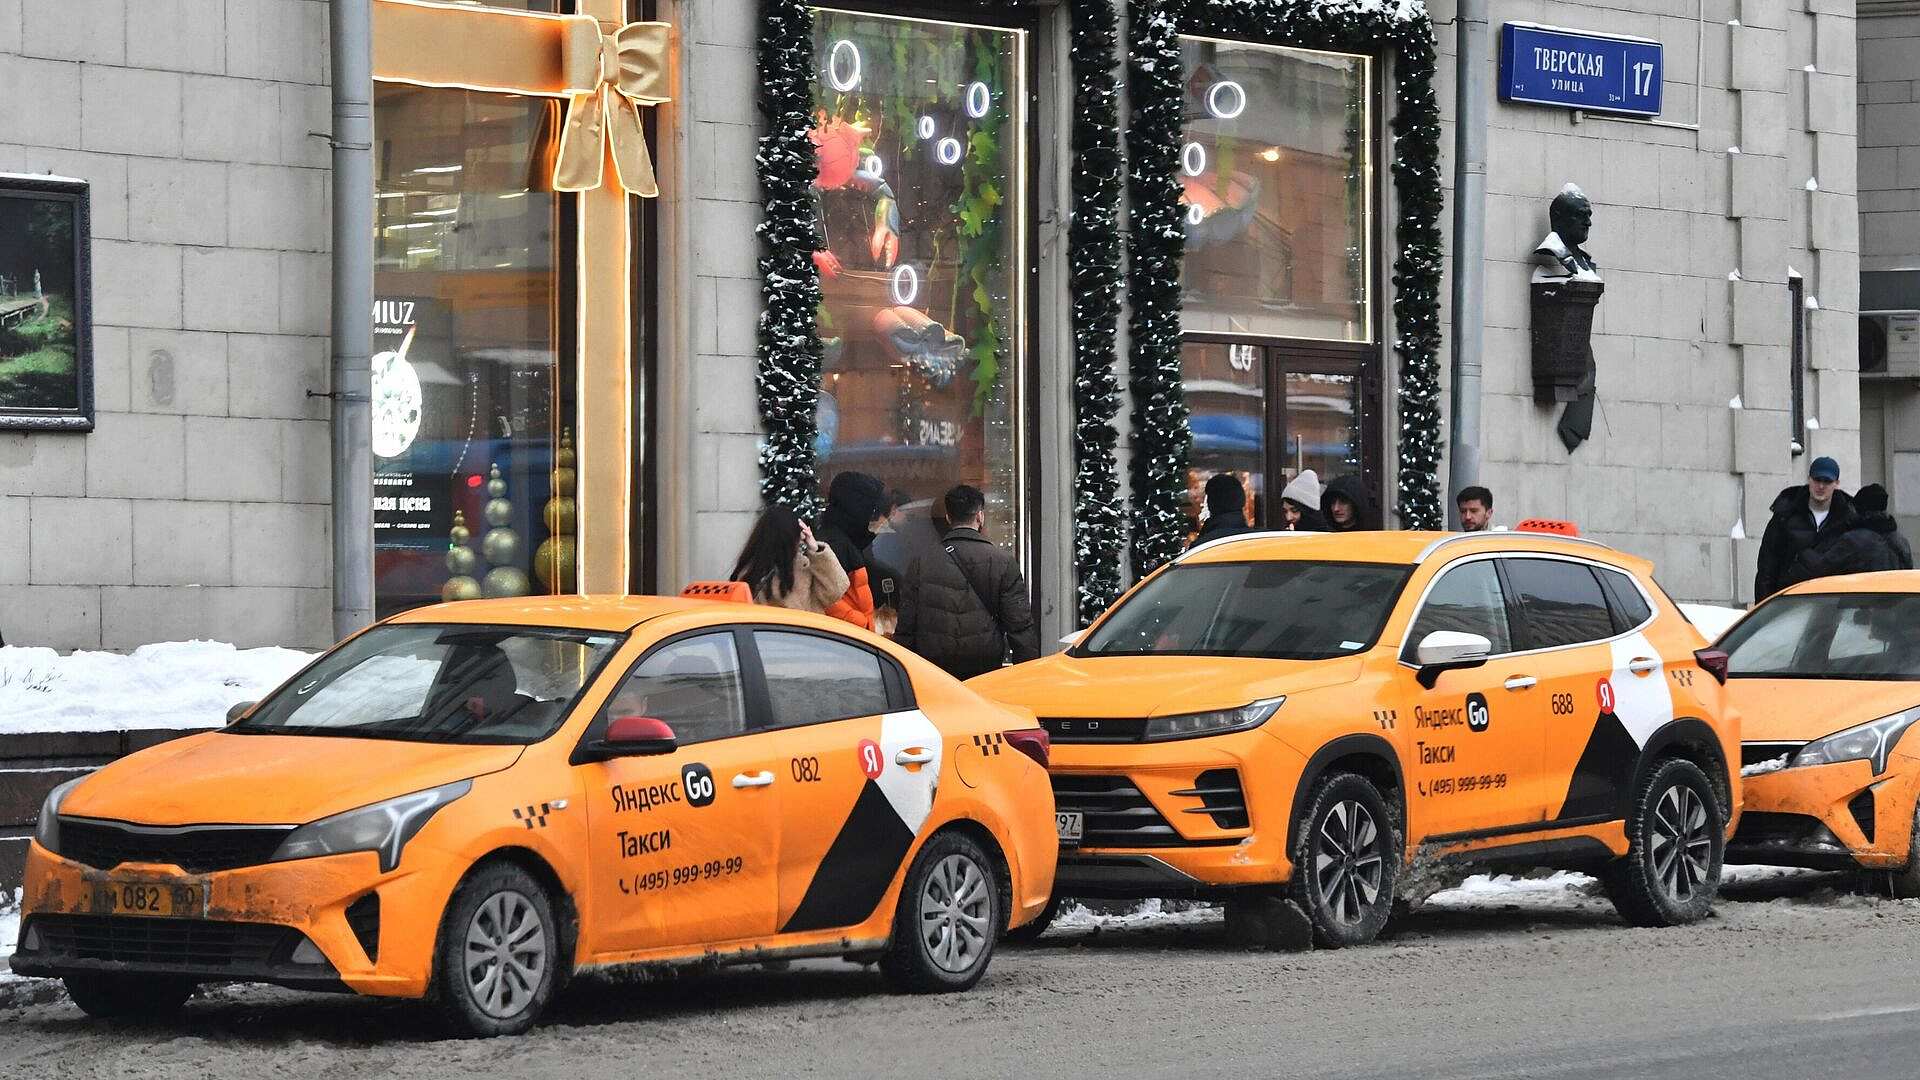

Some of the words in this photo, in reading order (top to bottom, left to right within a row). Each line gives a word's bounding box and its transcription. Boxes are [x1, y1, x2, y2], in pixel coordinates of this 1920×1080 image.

[1534, 47, 1604, 77] ТВЕРСКАЯ
[1551, 78, 1584, 93] УЛИЦА
[1632, 62, 1654, 97] 17
[399, 497, 431, 514] цена
[1414, 705, 1464, 730] Яндекс
[1468, 701, 1488, 726] Go
[1551, 692, 1574, 715] 688
[1417, 741, 1455, 765] Такси
[791, 756, 821, 783] 082
[611, 782, 681, 813] Яндекс
[685, 771, 713, 800] Go
[1429, 777, 1455, 797] (495)
[1457, 773, 1507, 792] 999-99-99
[617, 829, 671, 859] Такси
[634, 869, 669, 895] (495)
[673, 856, 743, 886] 999-99-99
[123, 886, 160, 911] 082
